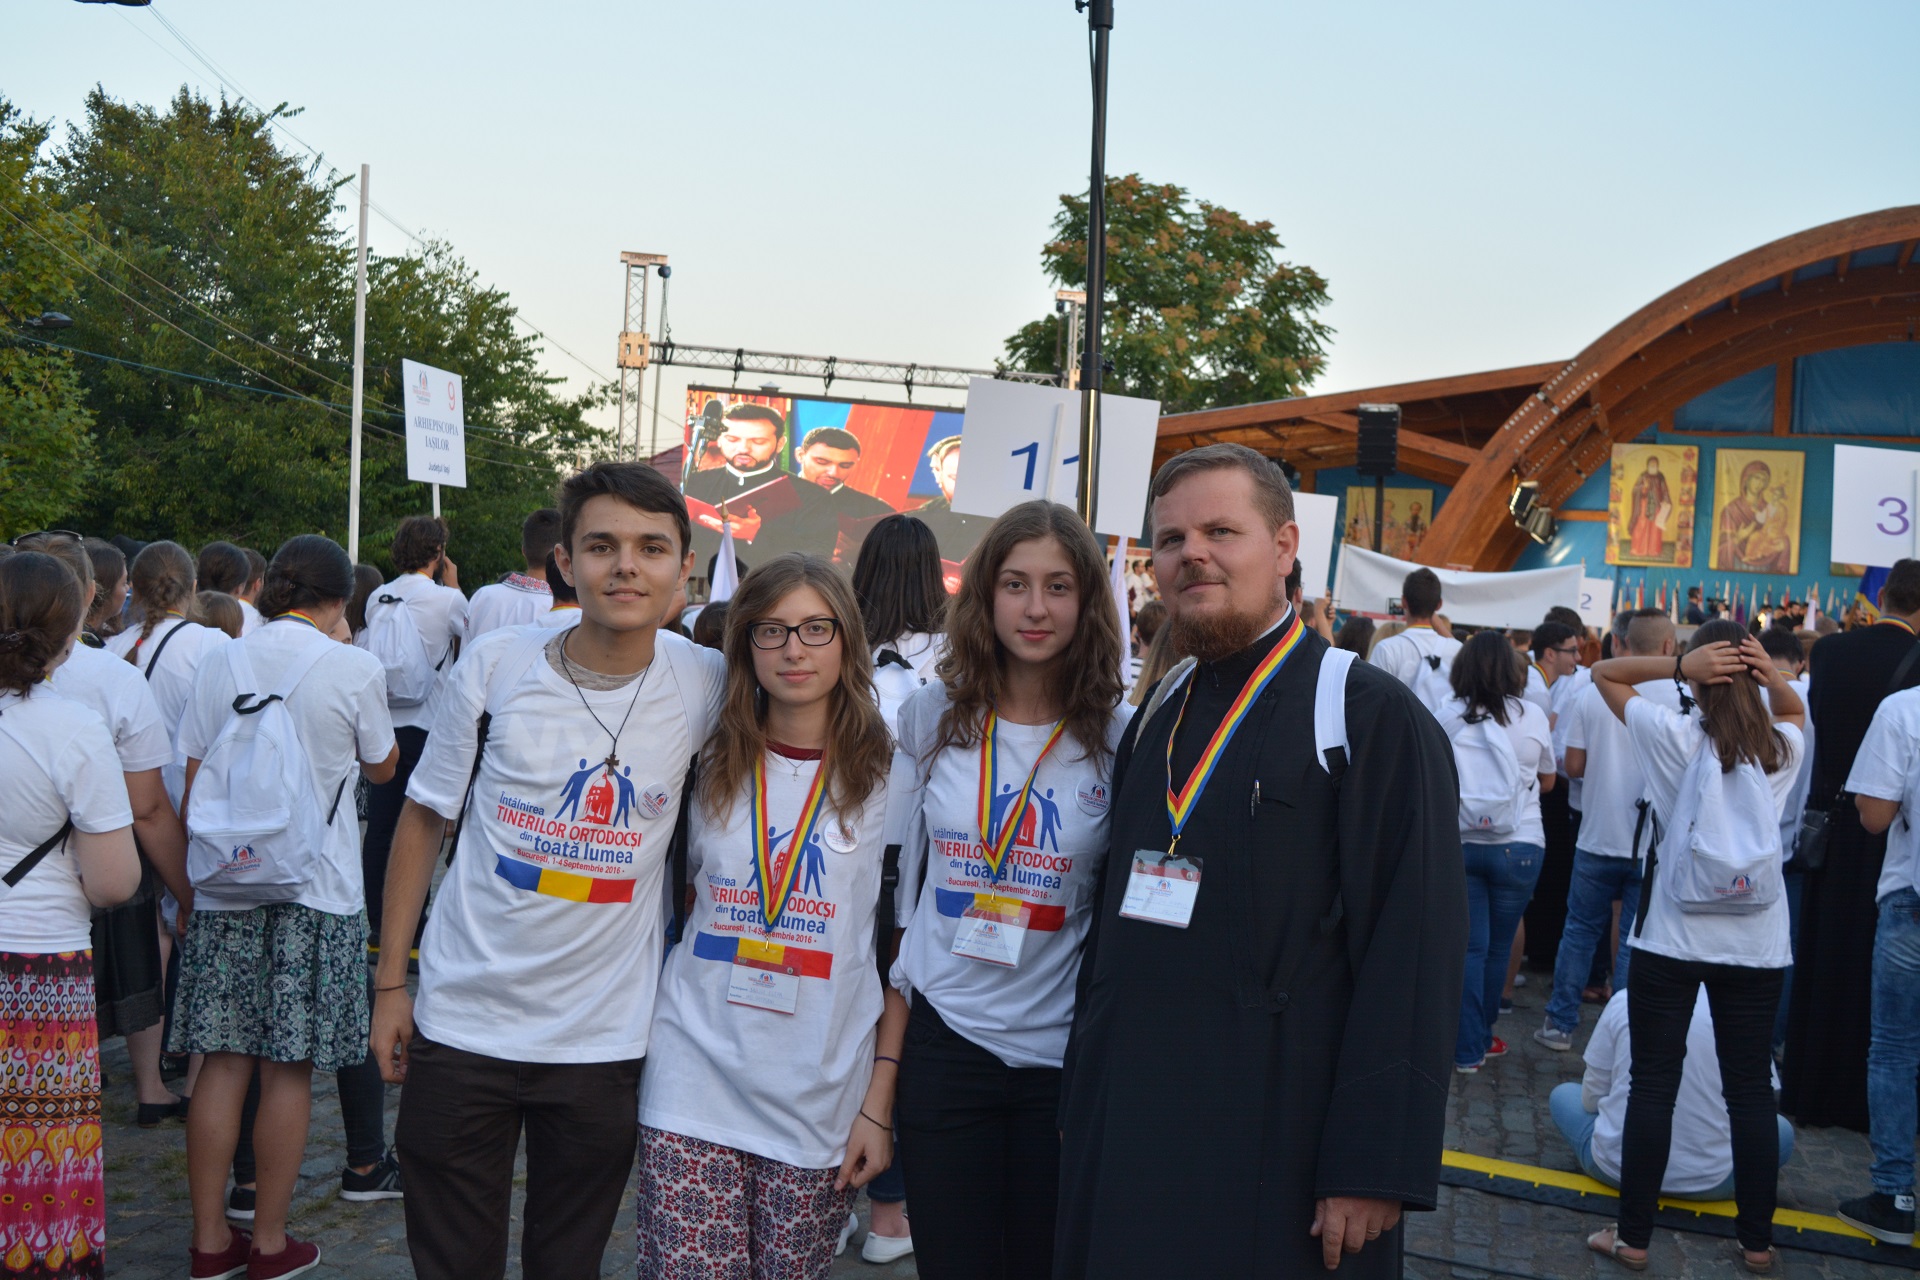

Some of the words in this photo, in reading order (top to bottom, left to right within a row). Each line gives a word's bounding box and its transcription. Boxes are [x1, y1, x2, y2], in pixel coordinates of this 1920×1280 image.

[447, 381, 456, 411] 9
[413, 416, 459, 436] ARHIEPISCOPIA
[1876, 497, 1909, 536] 3
[1580, 593, 1592, 610] 2
[499, 790, 545, 816] Întâlnirea
[497, 804, 567, 839] TINERILOR
[569, 825, 642, 850] ORTODOCȘI
[519, 831, 533, 842] din
[534, 835, 580, 859] toată
[583, 842, 633, 864] lumea
[934, 840, 984, 860] TINERILO
[1005, 850, 1072, 876] RTODOCȘI
[552, 857, 563, 867] 1-4
[563, 859, 604, 873] Septembrie
[605, 865, 621, 874] 2016
[949, 859, 962, 868] din
[1012, 864, 1061, 889] lumea
[1031, 888, 1048, 899] 2016
[715, 904, 729, 914] din
[730, 905, 763, 925] toat
[776, 914, 826, 934] umea
[748, 925, 758, 935] 1-4
[796, 934, 813, 944] 2016
